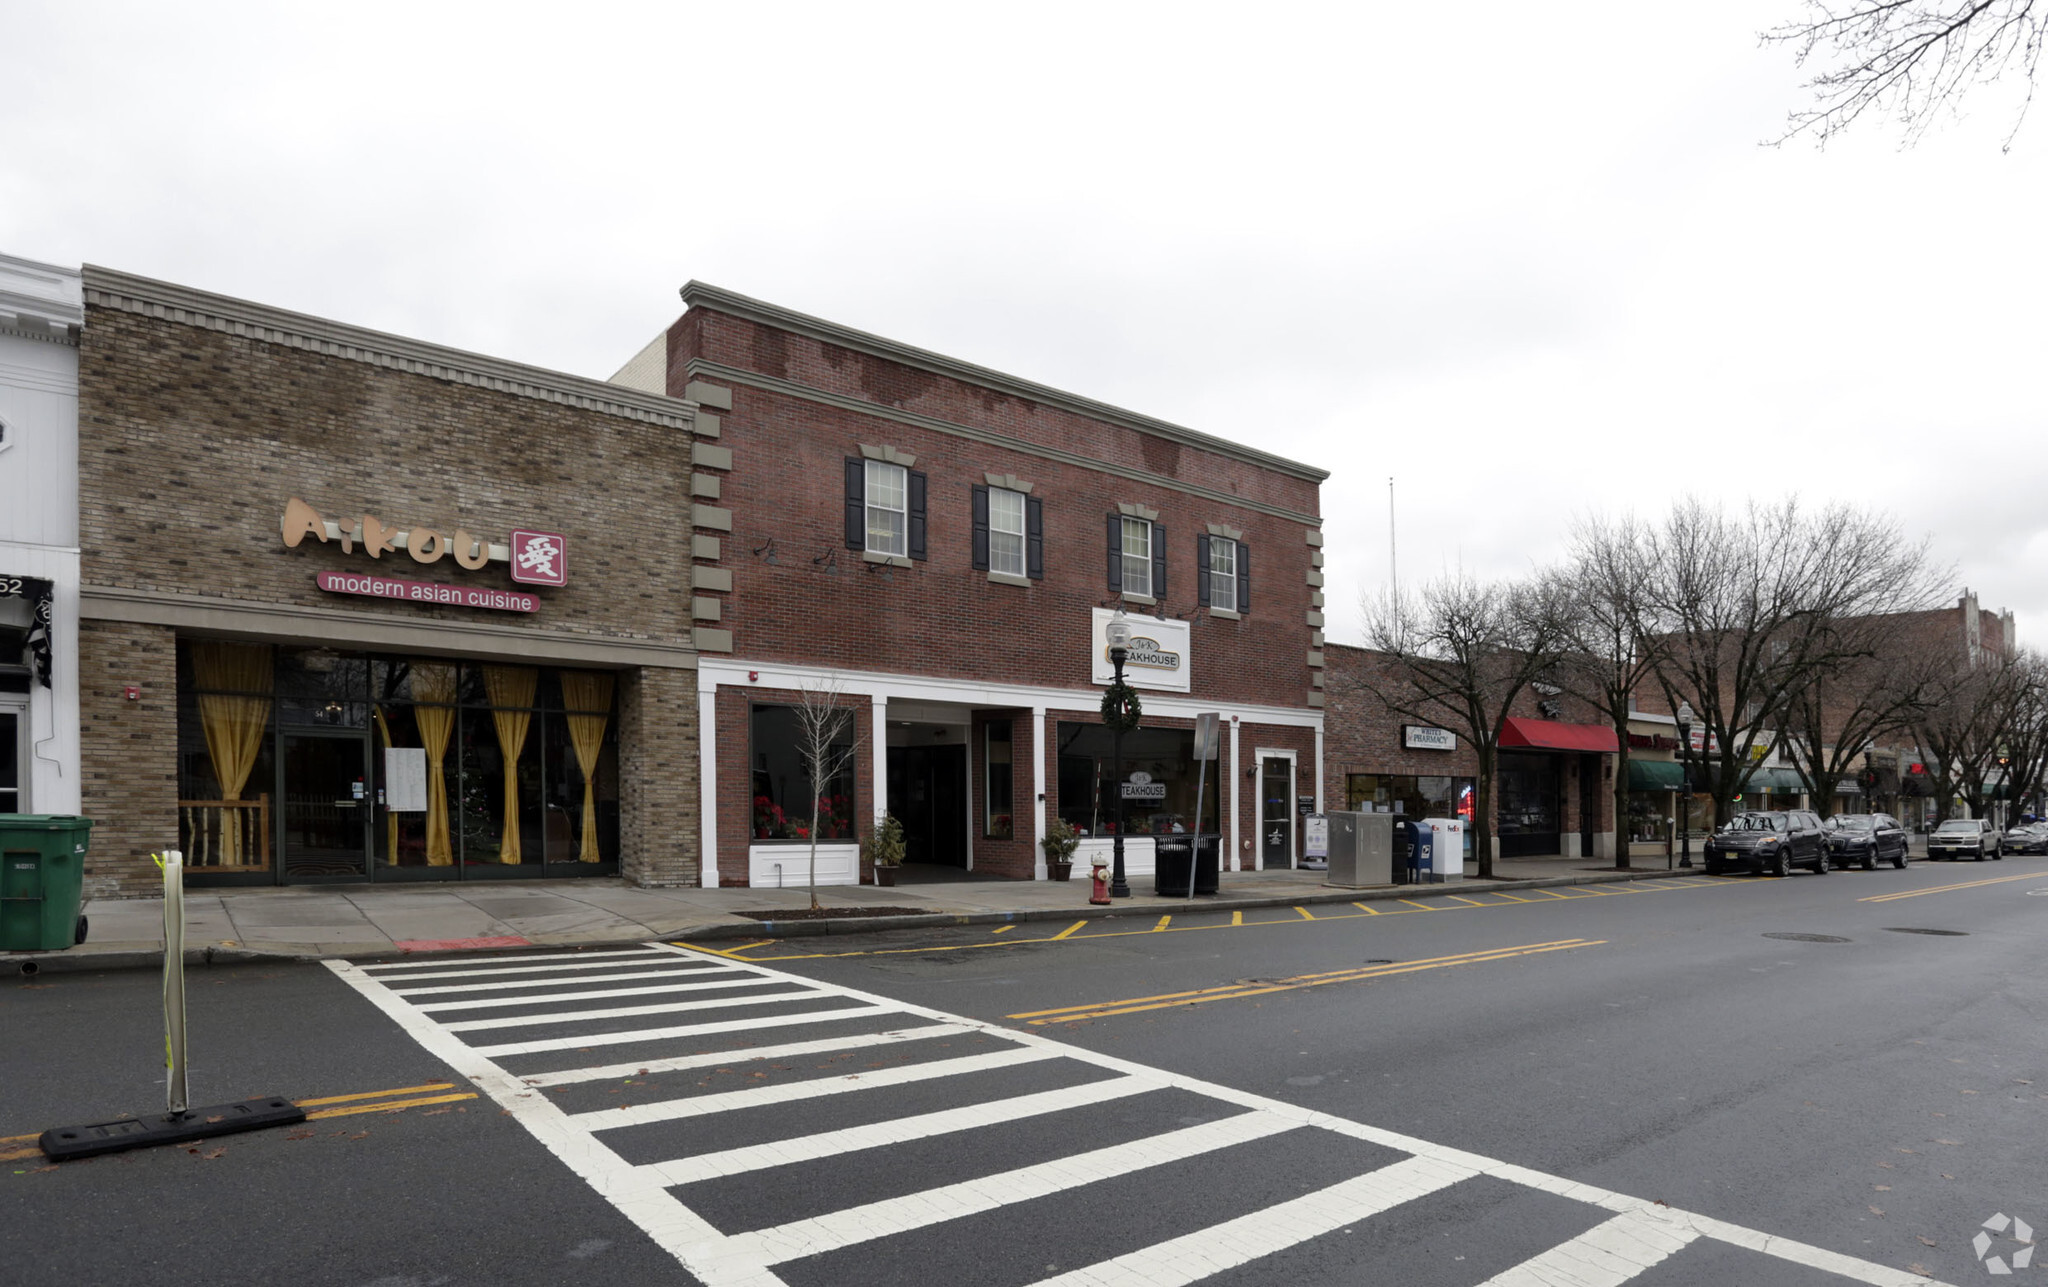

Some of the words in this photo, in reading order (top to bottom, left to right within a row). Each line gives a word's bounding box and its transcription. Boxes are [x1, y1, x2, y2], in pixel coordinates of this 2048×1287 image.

[517, 536, 560, 578] 愛
[327, 574, 406, 597] modern
[410, 583, 463, 605] asian
[467, 591, 533, 611] cuisine
[1413, 733, 1448, 744] PHARMACY
[1121, 785, 1165, 796] TEAKHOUSE
[1447, 825, 1460, 833] FedEx
